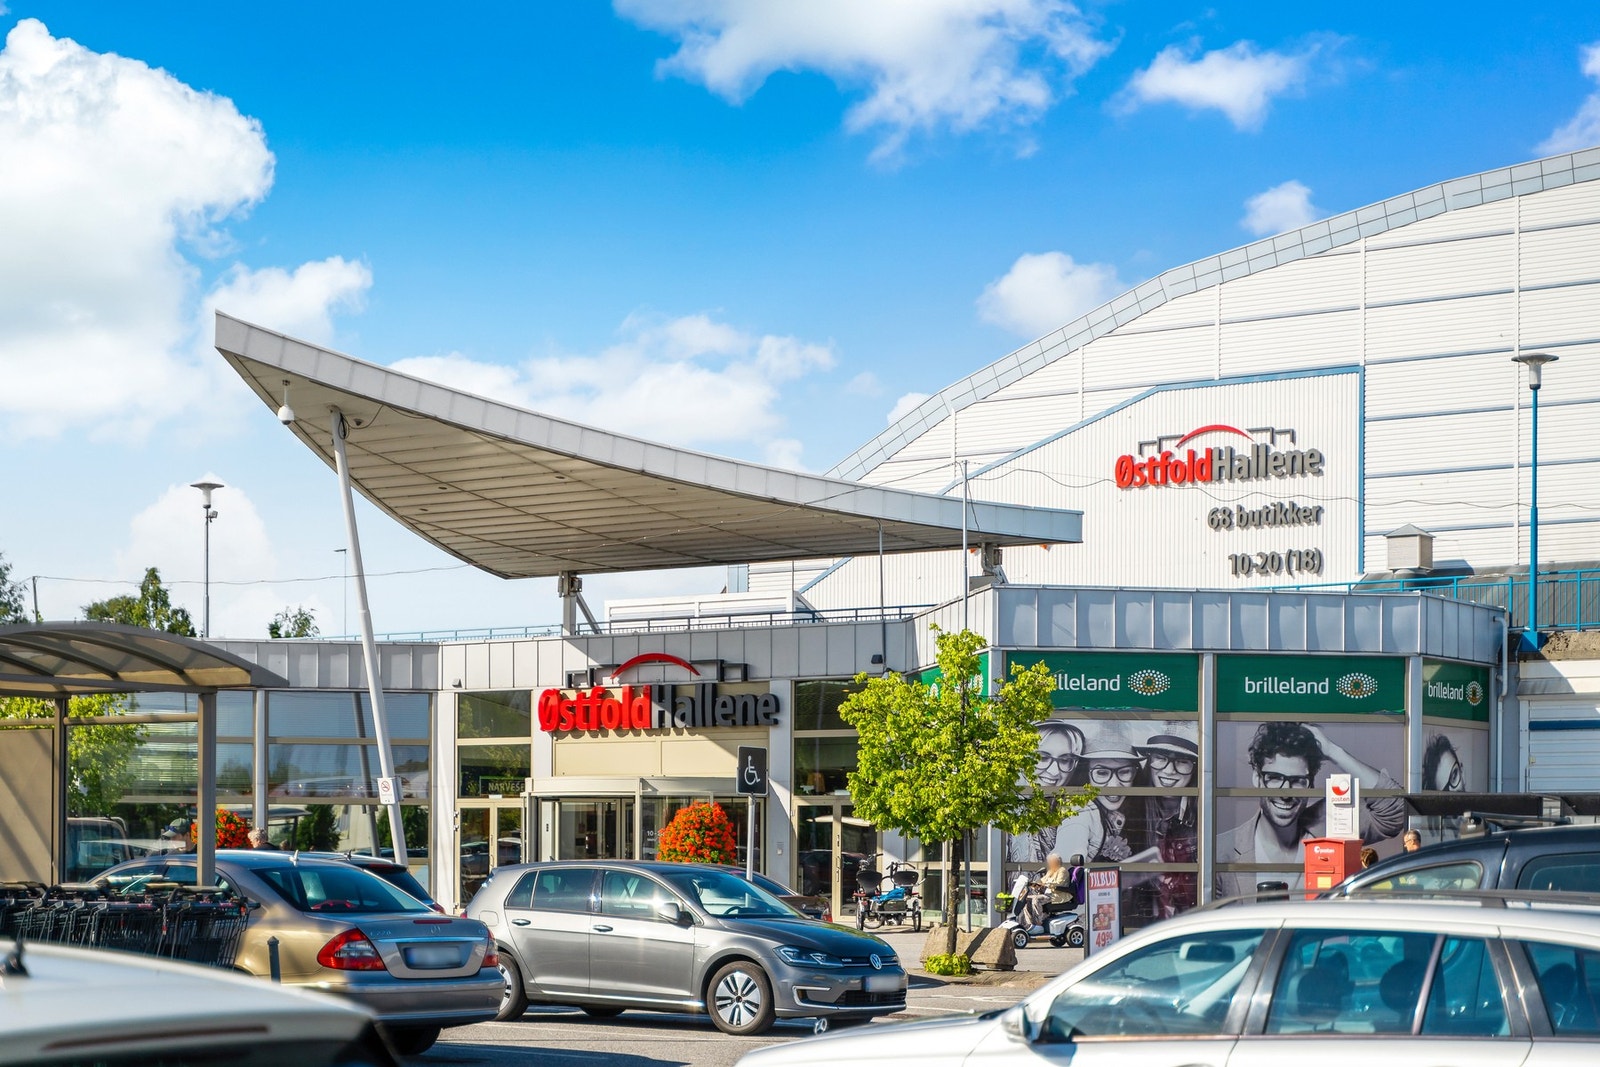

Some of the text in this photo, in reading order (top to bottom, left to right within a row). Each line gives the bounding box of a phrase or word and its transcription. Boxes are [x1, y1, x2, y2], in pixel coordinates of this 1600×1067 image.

[1115, 443, 1324, 488] ØstfoldHallene
[1207, 501, 1323, 531] 68 butikker
[1228, 547, 1323, 578] 10-20 (18)
[1053, 674, 1121, 691] illeland
[1245, 676, 1329, 694] brilleland
[1428, 681, 1464, 701] brilleland
[538, 683, 780, 732] ØstfoldHallene
[488, 782, 525, 792] NARVESE
[1090, 870, 1118, 888] TILBUD
